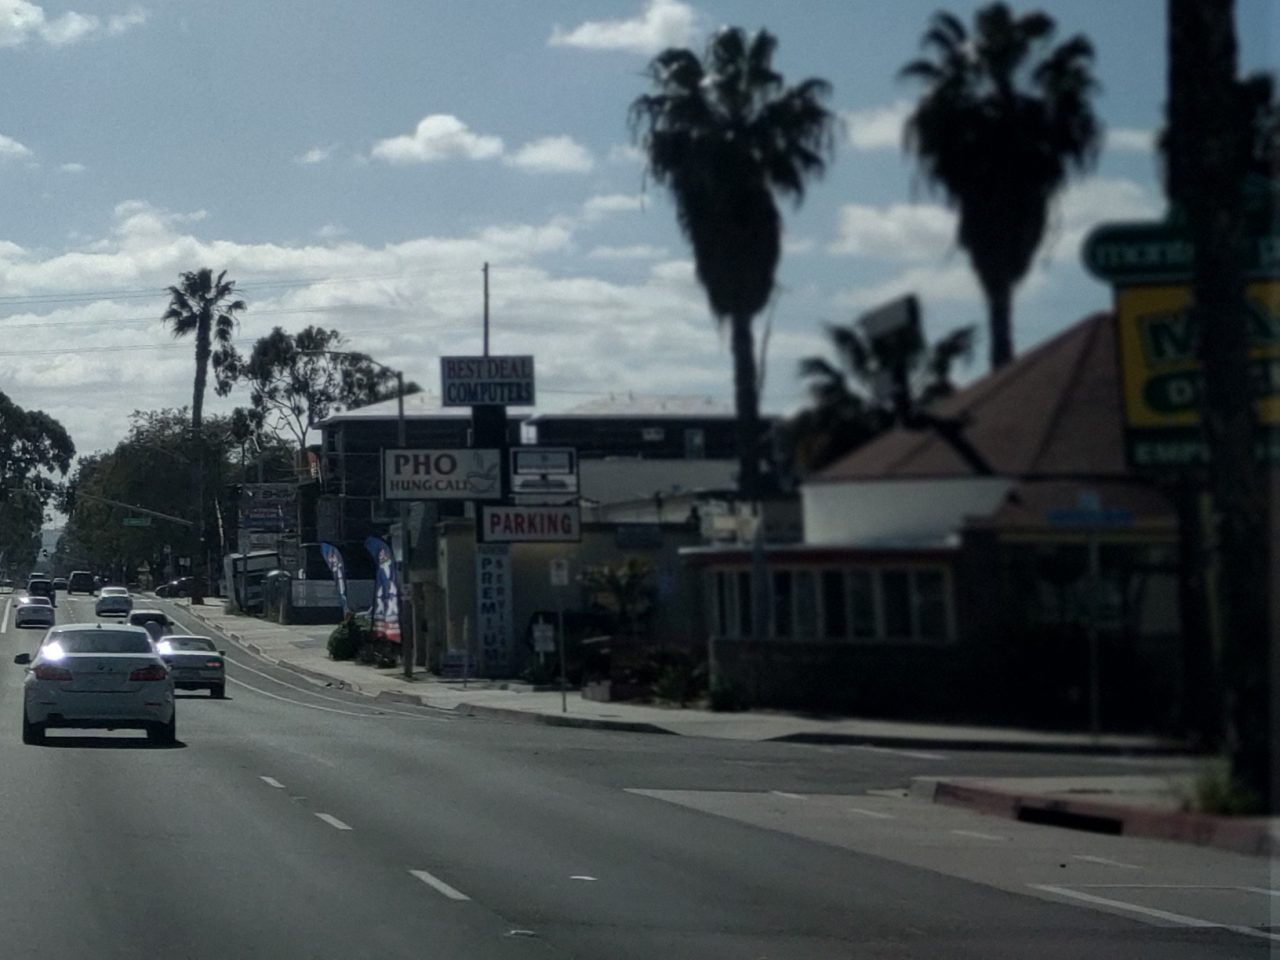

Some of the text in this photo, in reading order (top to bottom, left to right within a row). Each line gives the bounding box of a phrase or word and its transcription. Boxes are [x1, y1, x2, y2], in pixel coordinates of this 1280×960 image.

[447, 359, 530, 379] BEST DEAL
[448, 382, 531, 402] COMPUTERS
[394, 454, 457, 475] PHO
[490, 513, 572, 534] PARKING
[481, 558, 498, 661] PREMIUM
